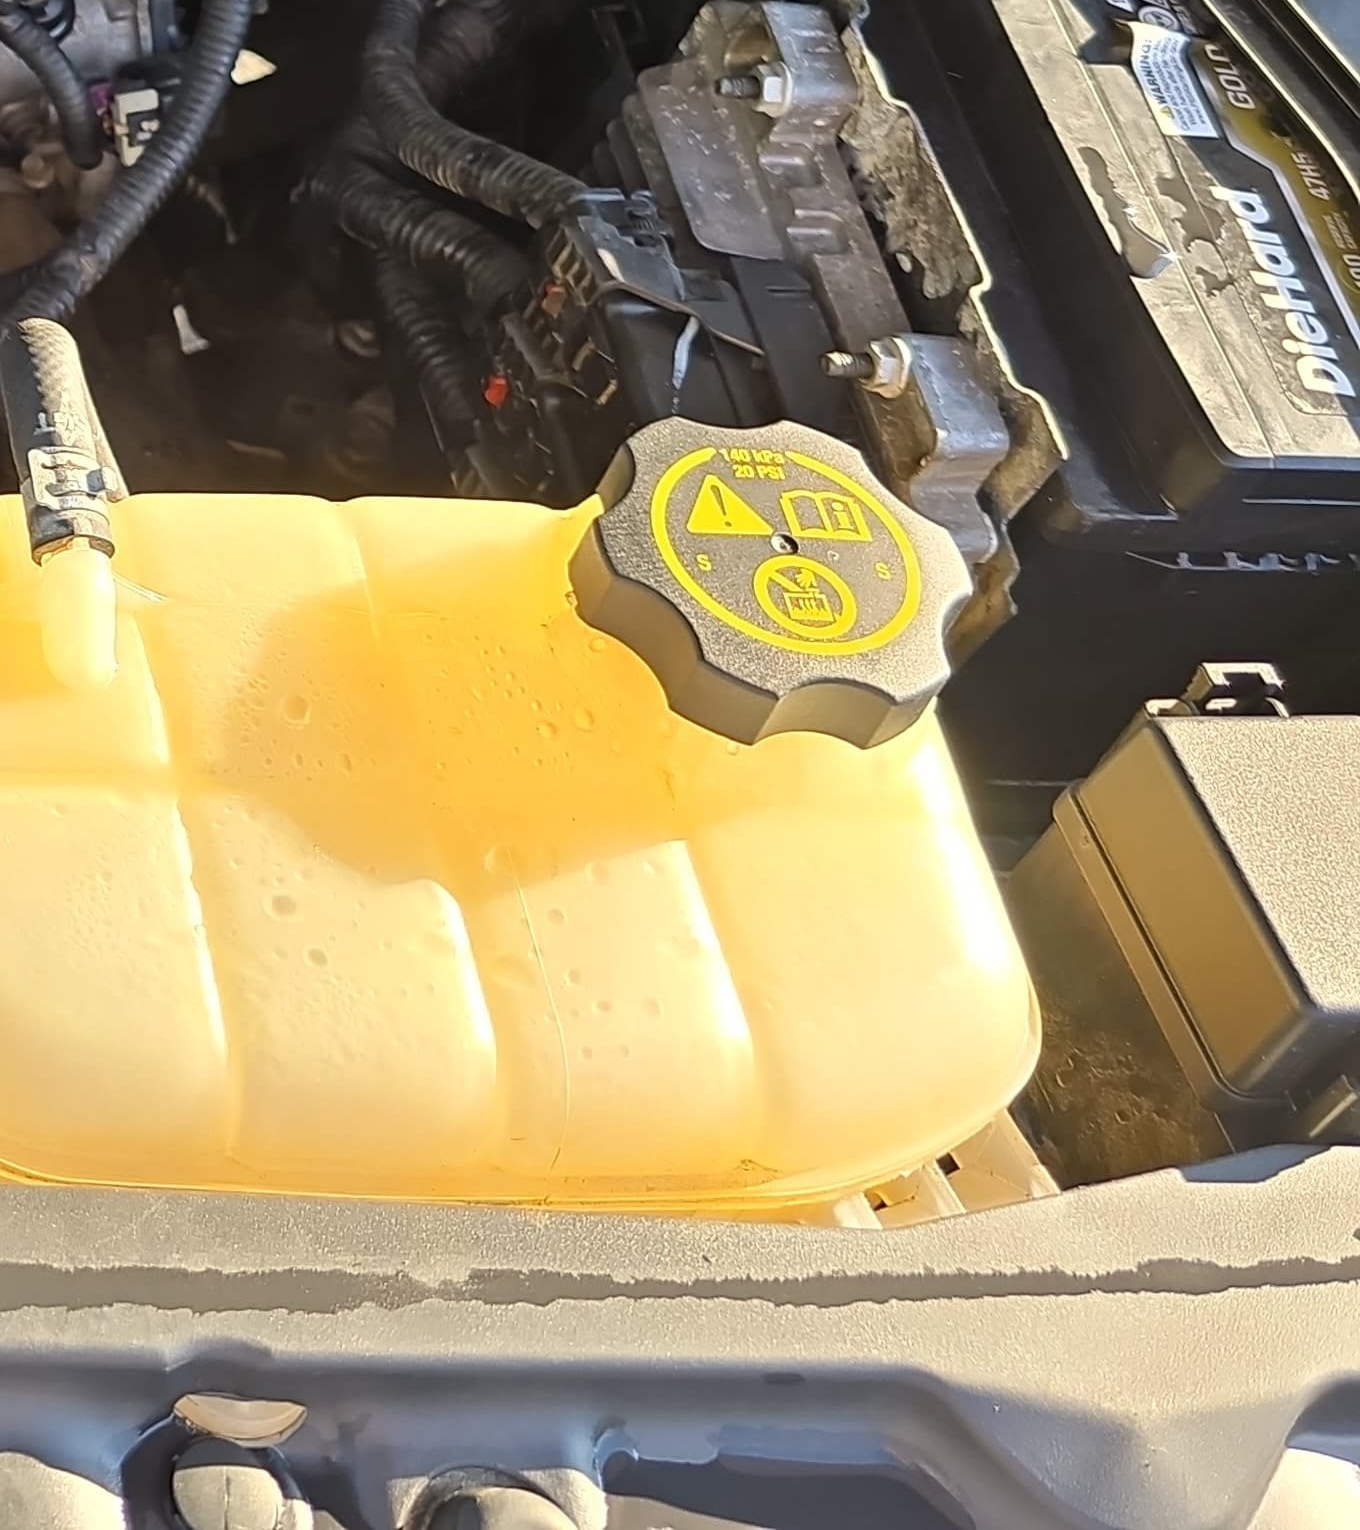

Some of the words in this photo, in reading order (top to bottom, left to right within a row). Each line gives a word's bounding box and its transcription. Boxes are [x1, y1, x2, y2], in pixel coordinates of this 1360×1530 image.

[1208, 184, 1357, 398] DieHard
[718, 447, 751, 463] 140
[751, 448, 786, 465] kPa
[732, 463, 755, 479] 20
[755, 464, 786, 481] PSI
[696, 553, 712, 573] S
[875, 562, 892, 582] S
